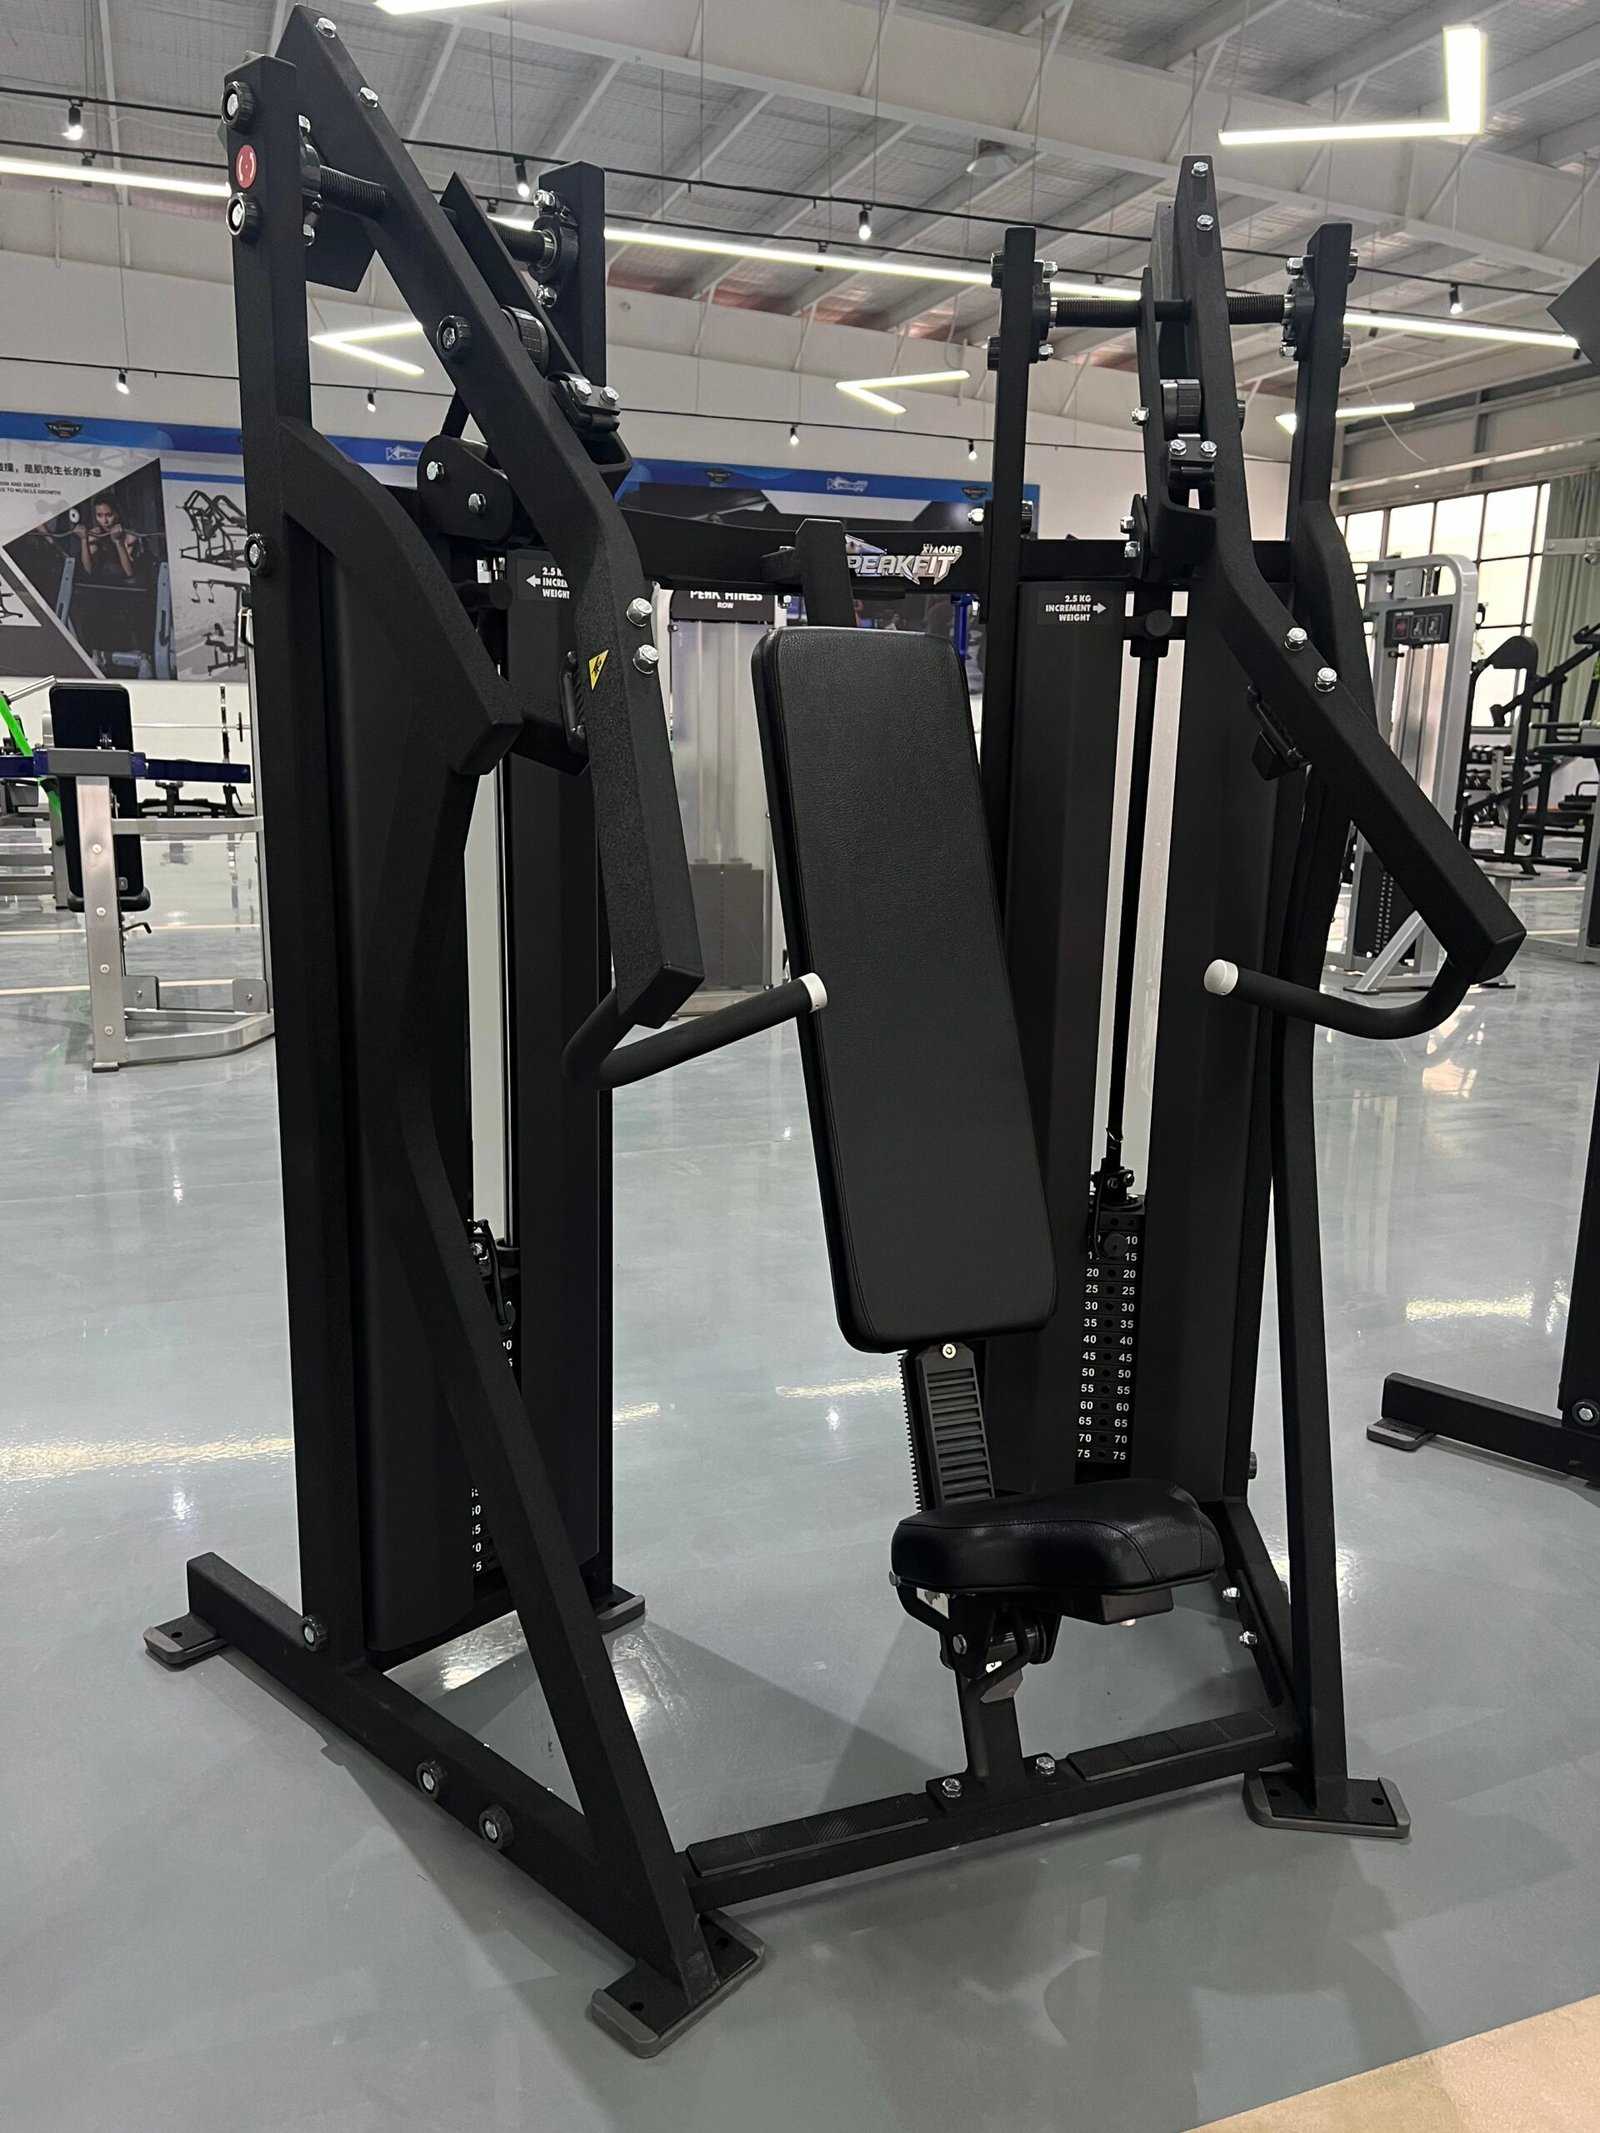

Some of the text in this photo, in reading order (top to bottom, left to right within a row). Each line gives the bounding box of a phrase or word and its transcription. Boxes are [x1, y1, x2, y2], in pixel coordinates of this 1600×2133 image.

[921, 545, 962, 555] XIAOKE
[542, 566, 556, 576] 2.5
[1064, 594, 1091, 602] 2.5 KG
[1045, 604, 1091, 612] INCREMENT
[1059, 613, 1091, 621] WEIGHT
[1125, 1235, 1138, 1245] 10
[1125, 1252, 1137, 1262] 15
[1086, 1267, 1136, 1279] 20 20
[1085, 1284, 1135, 1296] 25 25
[1084, 1301, 1135, 1312] 30 30
[1083, 1318, 1134, 1329] 35 35
[1082, 1334, 1133, 1346] 40 40
[1082, 1351, 1133, 1363] 45 45
[1081, 1367, 1131, 1379] 50 50
[1080, 1383, 1130, 1395] 55 55
[1080, 1400, 1130, 1412] 60 60
[1078, 1416, 1128, 1428] 65 65
[1078, 1433, 1128, 1444] 70 70
[1077, 1448, 1126, 1461] 75 75
